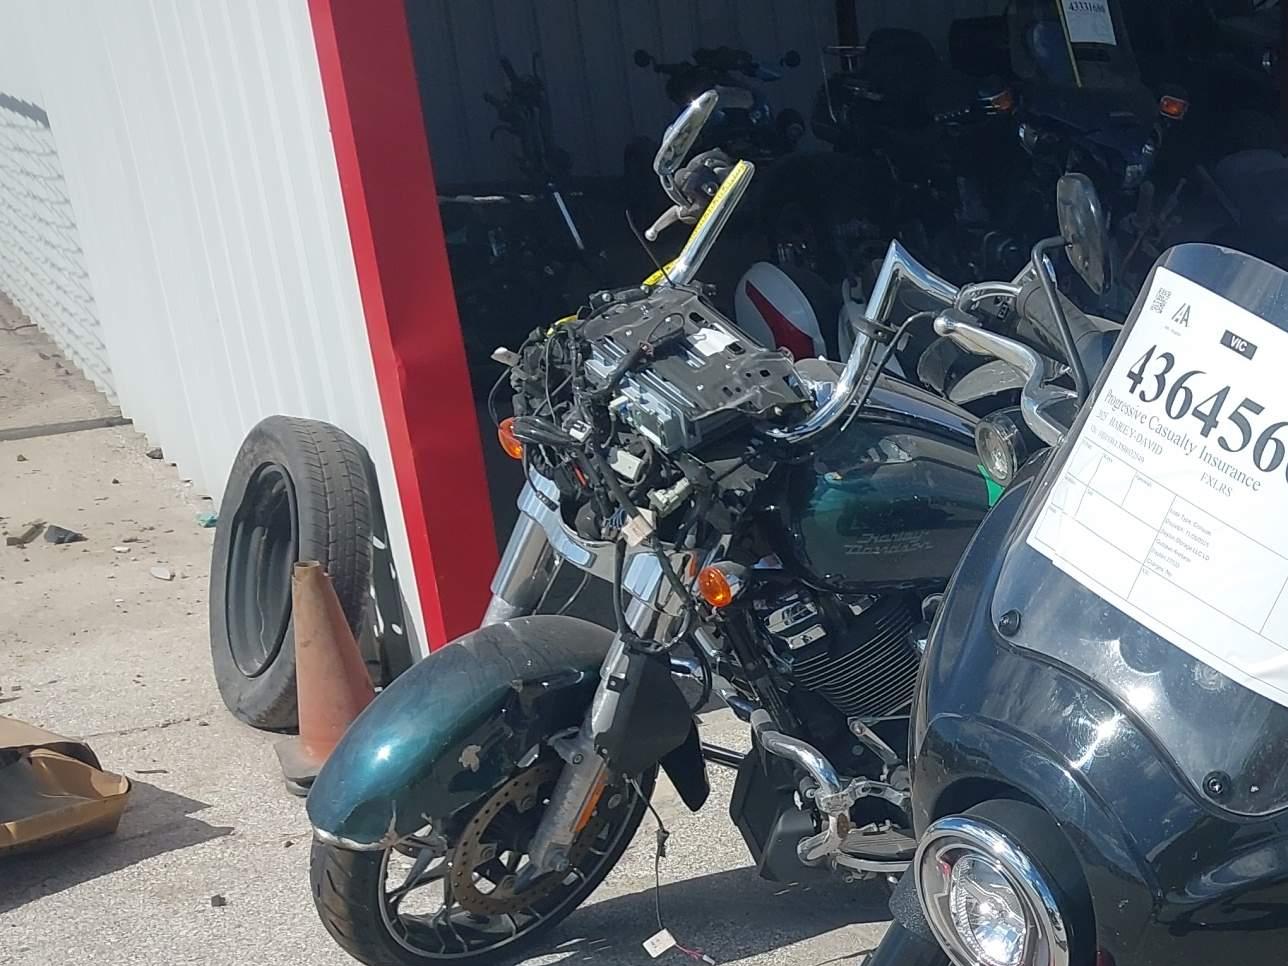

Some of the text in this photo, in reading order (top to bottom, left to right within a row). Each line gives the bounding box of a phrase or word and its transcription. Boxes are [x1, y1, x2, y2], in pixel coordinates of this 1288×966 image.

[1230, 335, 1248, 353] VIC
[1104, 389, 1148, 425] Progressive
[1148, 415, 1198, 457] Casualty
[1199, 445, 1262, 492] Insurance
